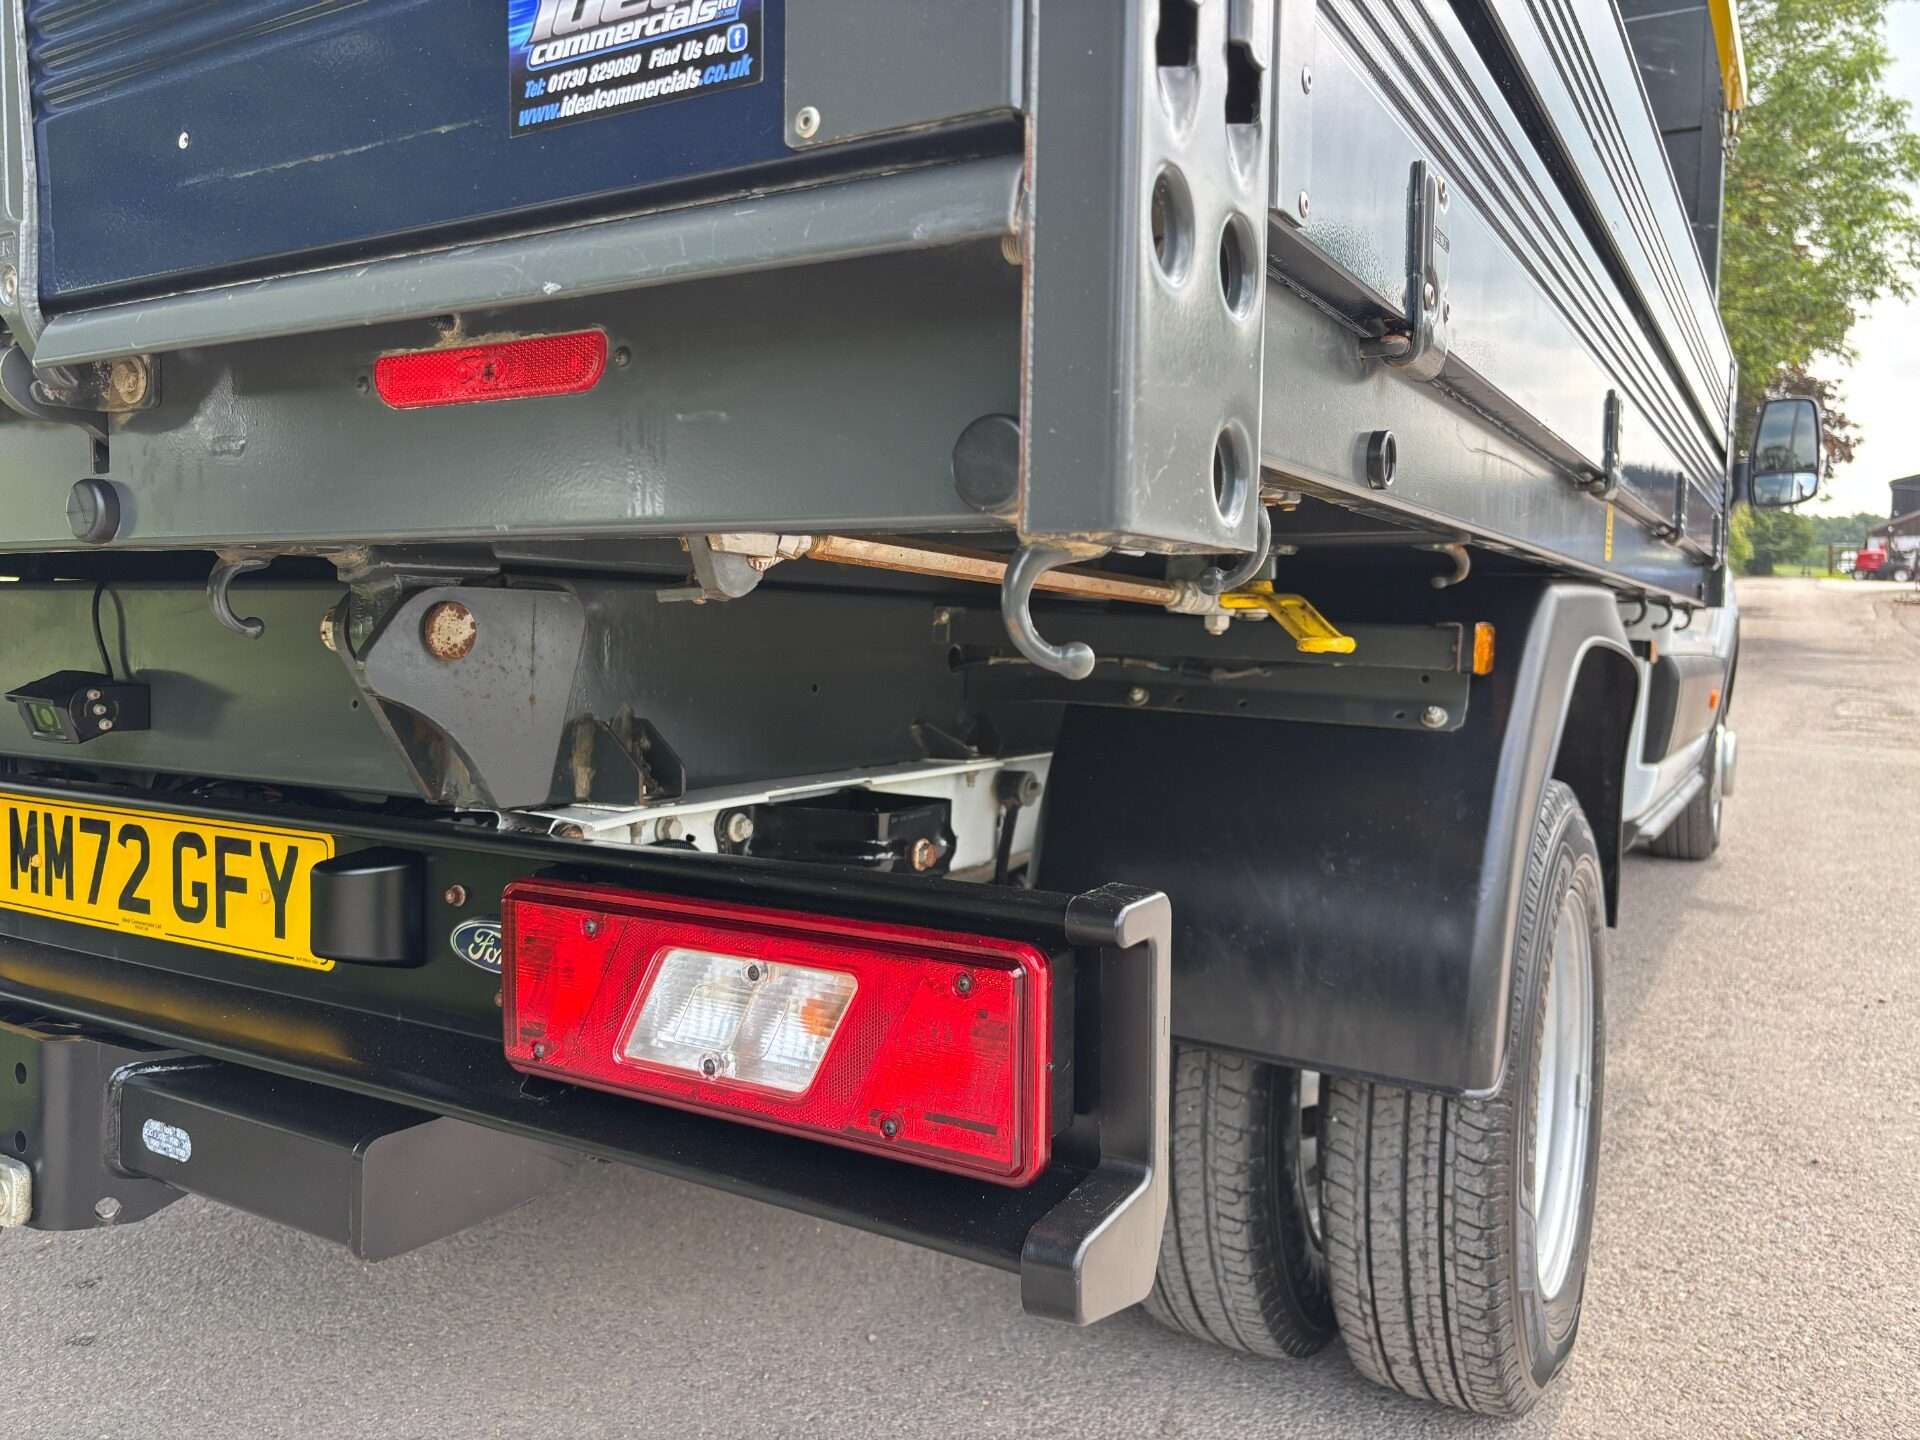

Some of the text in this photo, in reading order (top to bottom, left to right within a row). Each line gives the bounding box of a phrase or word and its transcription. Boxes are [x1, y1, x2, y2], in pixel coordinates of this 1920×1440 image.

[525, 78, 546, 98] Tel:
[547, 67, 588, 93] 01730
[588, 53, 642, 84] 829080
[648, 43, 683, 69] Find
[683, 40, 704, 61] Us
[705, 34, 726, 56] On
[530, 0, 718, 66] commercials
[518, 54, 753, 126] www.idealcommercials.co.uk
[9, 807, 299, 939] MM72 GFY
